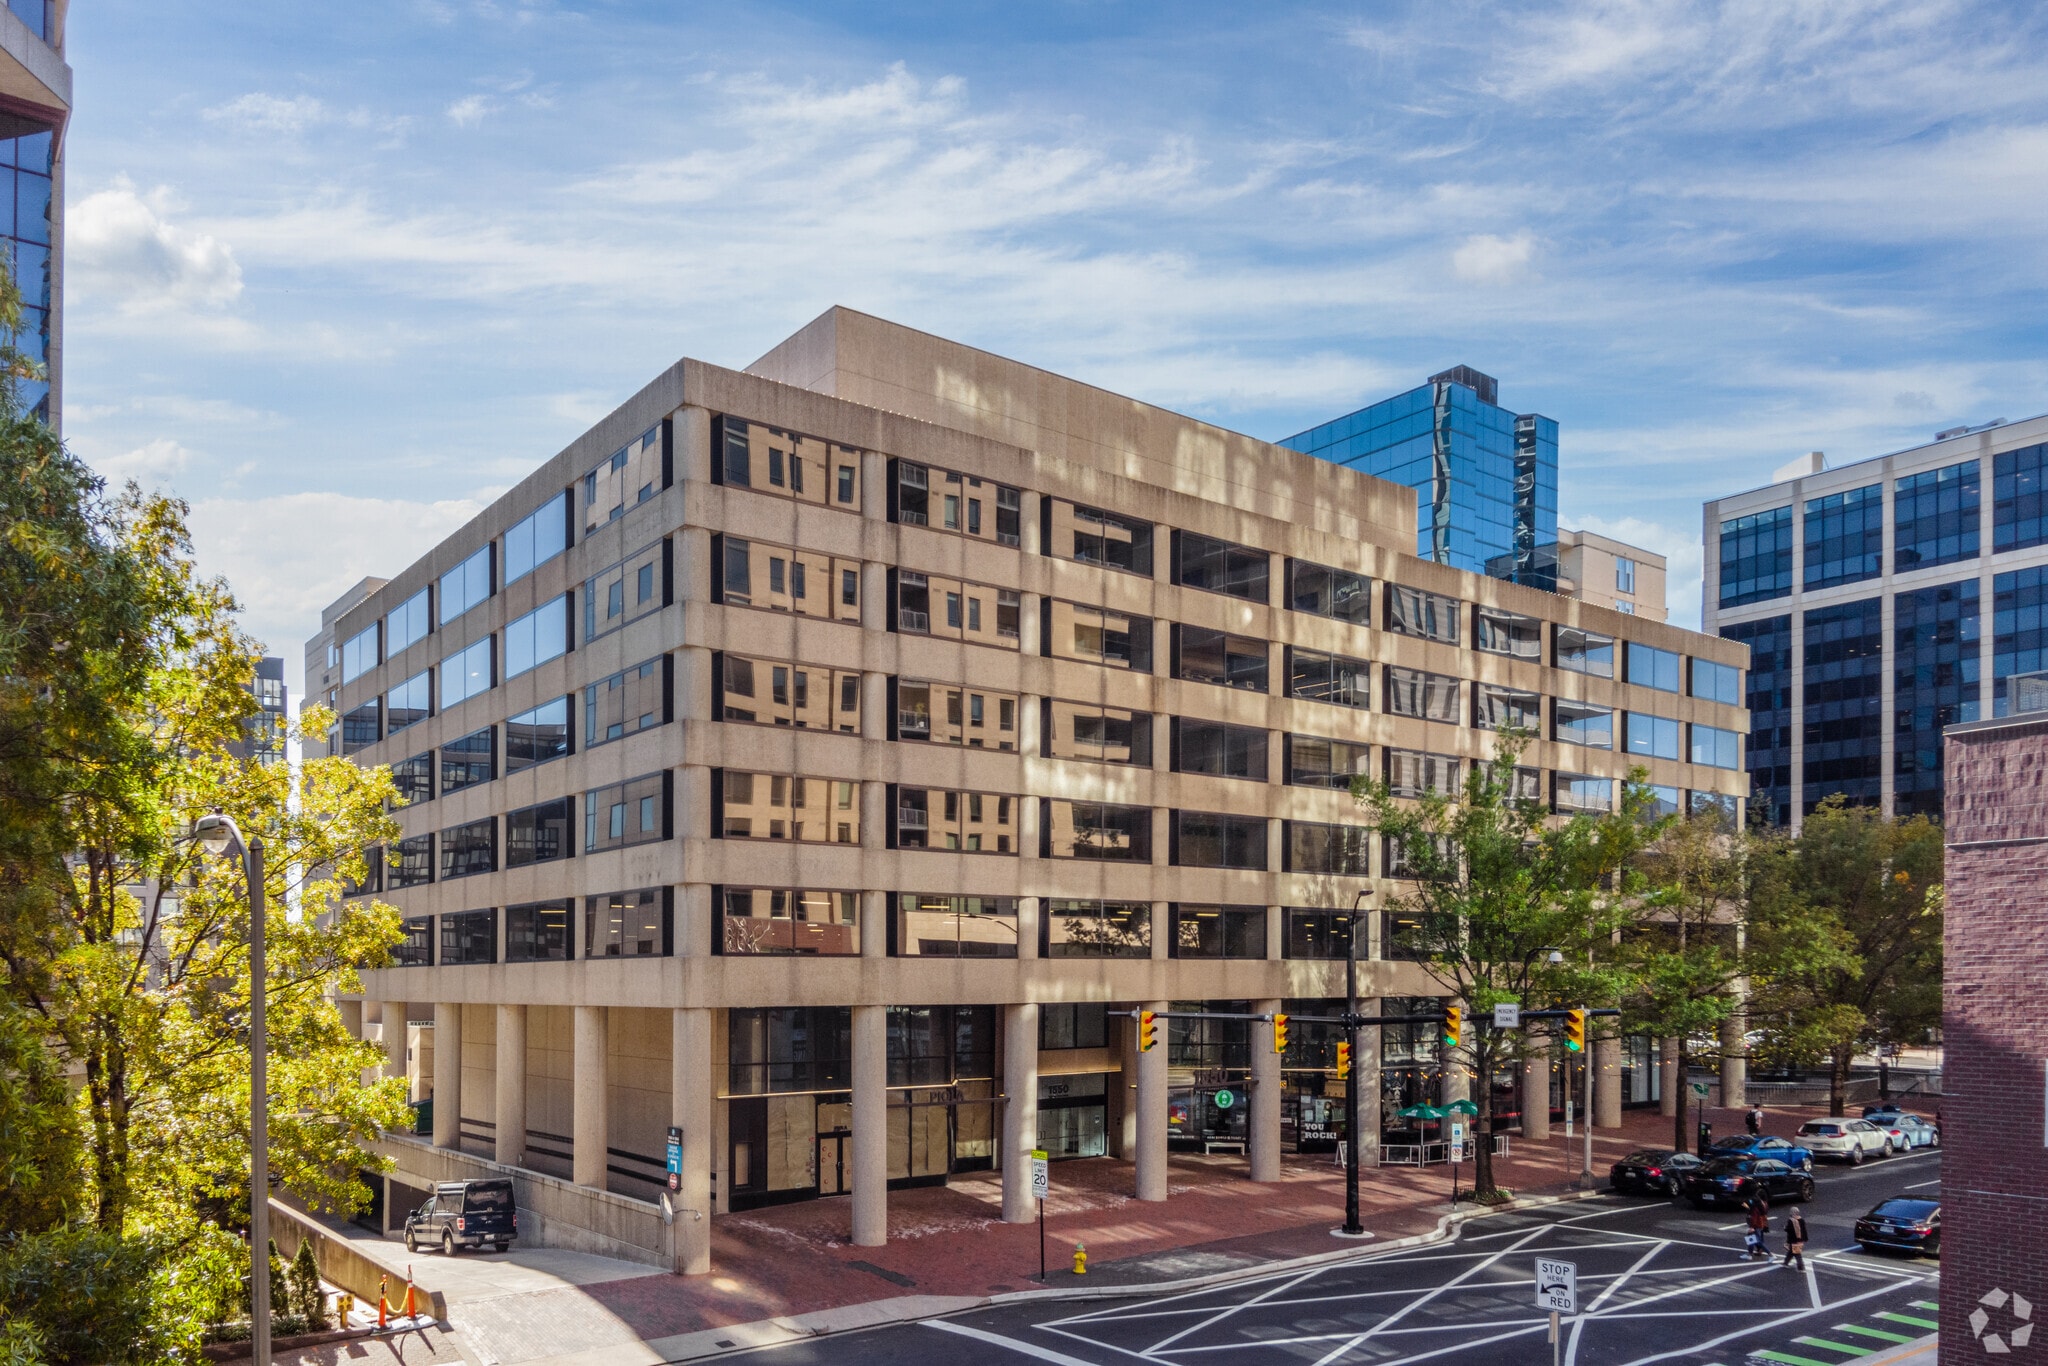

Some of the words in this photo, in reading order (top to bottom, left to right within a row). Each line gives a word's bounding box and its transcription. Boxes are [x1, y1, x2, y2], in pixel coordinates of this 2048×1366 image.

[1034, 1173, 1046, 1185] 20
[1542, 1263, 1570, 1275] STOP
[1547, 1275, 1565, 1283] HERE
[1550, 1296, 1571, 1308] RED
